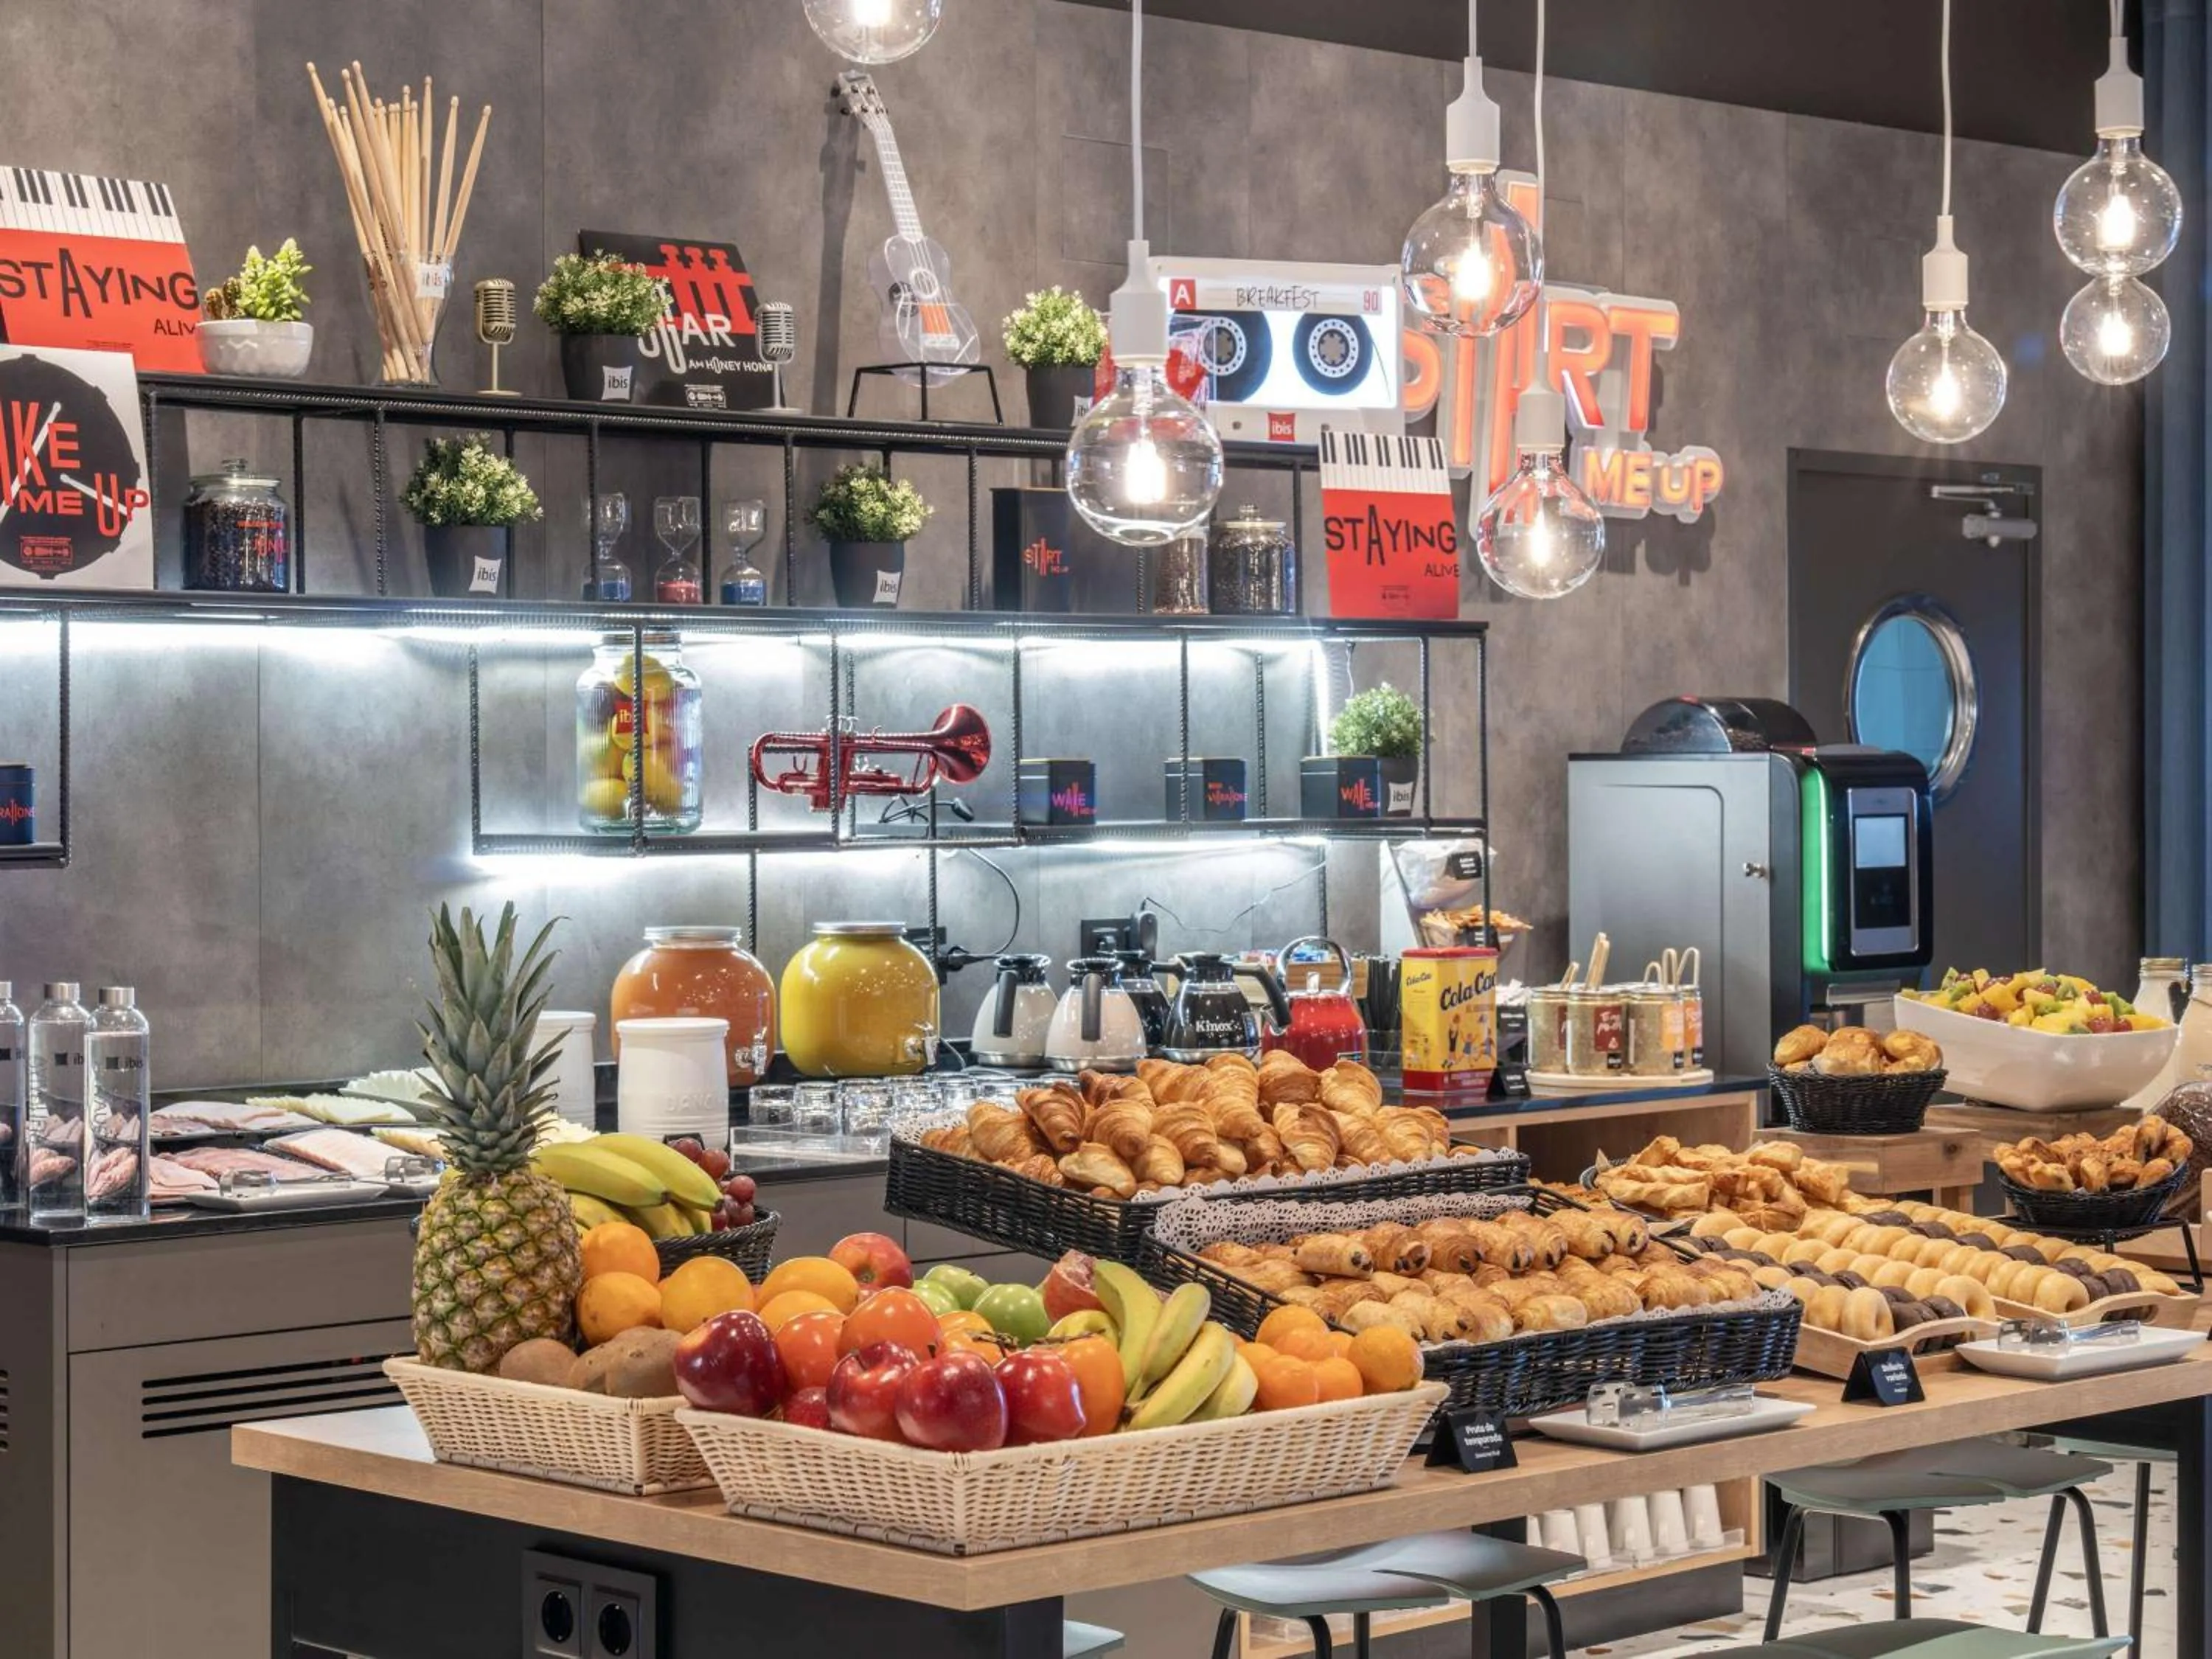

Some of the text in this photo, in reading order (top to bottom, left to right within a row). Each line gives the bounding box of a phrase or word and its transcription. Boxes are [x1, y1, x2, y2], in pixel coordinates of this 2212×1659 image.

[0, 248, 200, 318] STAYING
[1174, 283, 1192, 306] A
[1236, 285, 1320, 309] BREAKFEST
[1363, 290, 1379, 311] 90
[153, 319, 197, 336] ALIV
[706, 356, 742, 374] HONEY
[608, 375, 627, 389] ibis
[1271, 420, 1293, 436] ibis
[1585, 447, 1723, 512] ME UP
[18, 472, 150, 538] ME UP
[1324, 504, 1457, 567] STAYING
[477, 567, 496, 582] ibis
[1425, 563, 1461, 578] ALIVE
[619, 708, 633, 723] ib
